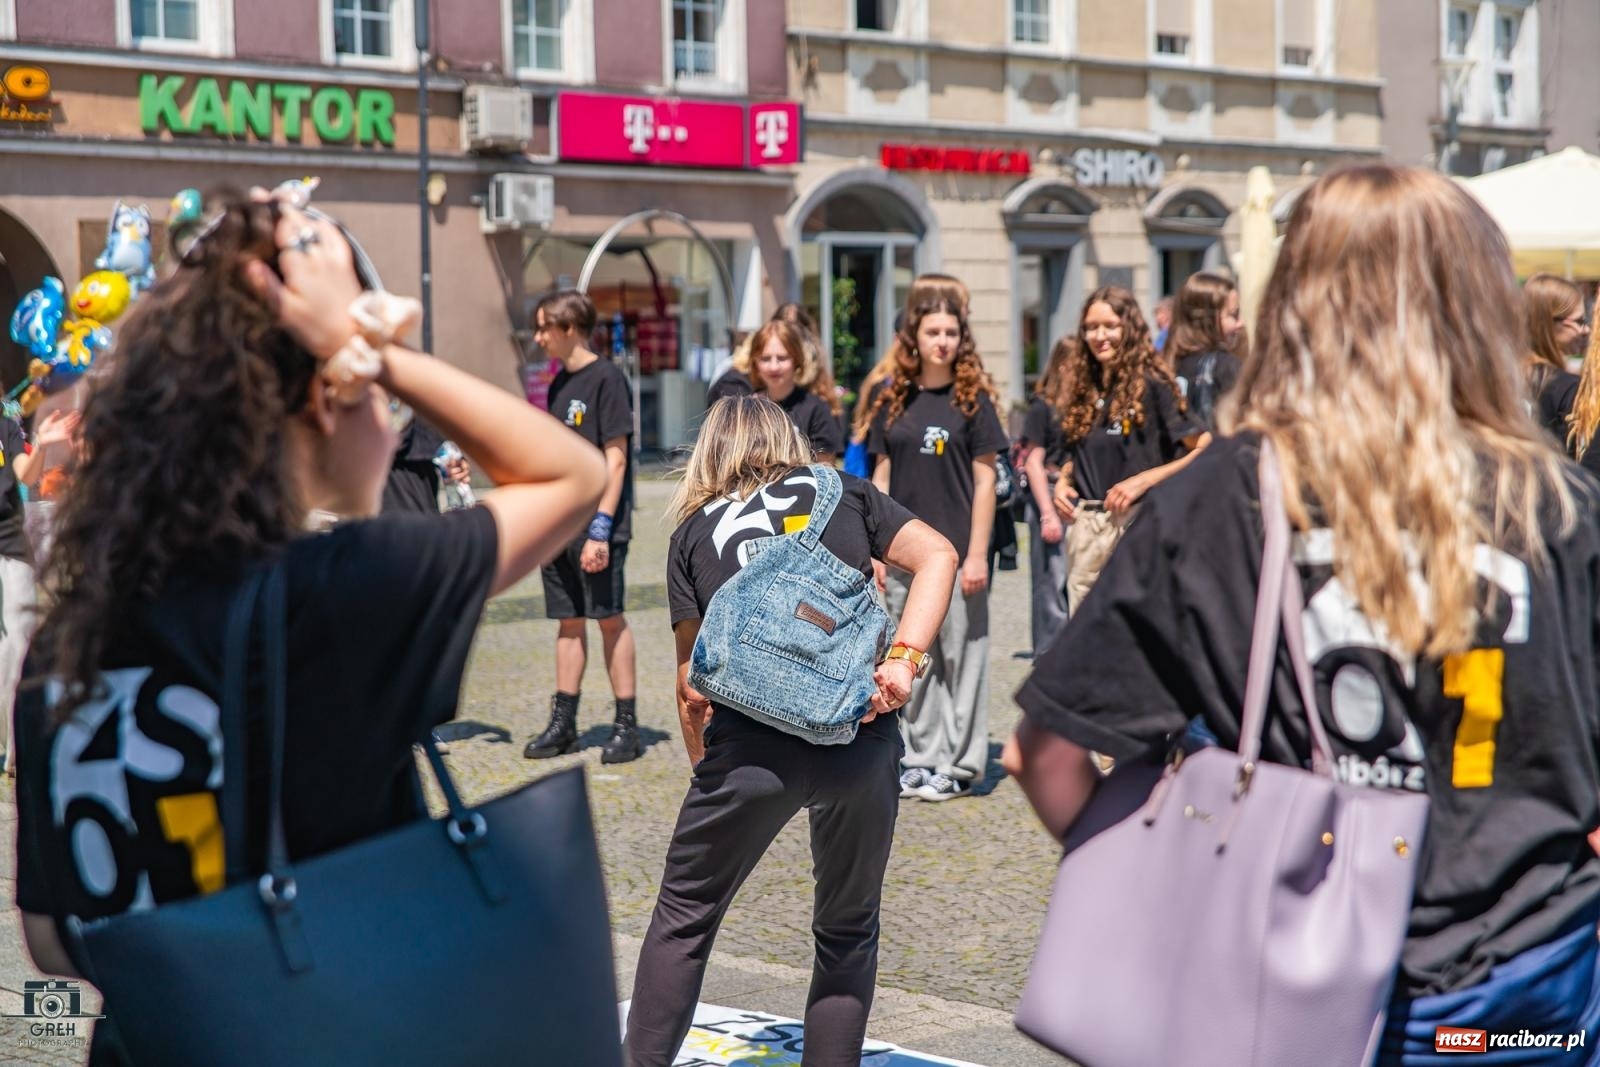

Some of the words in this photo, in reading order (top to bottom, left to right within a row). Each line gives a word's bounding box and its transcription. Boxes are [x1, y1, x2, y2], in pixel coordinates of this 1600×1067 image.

[139, 73, 395, 145] KANTOR
[755, 111, 788, 158] T
[1074, 147, 1164, 187] SHIRO
